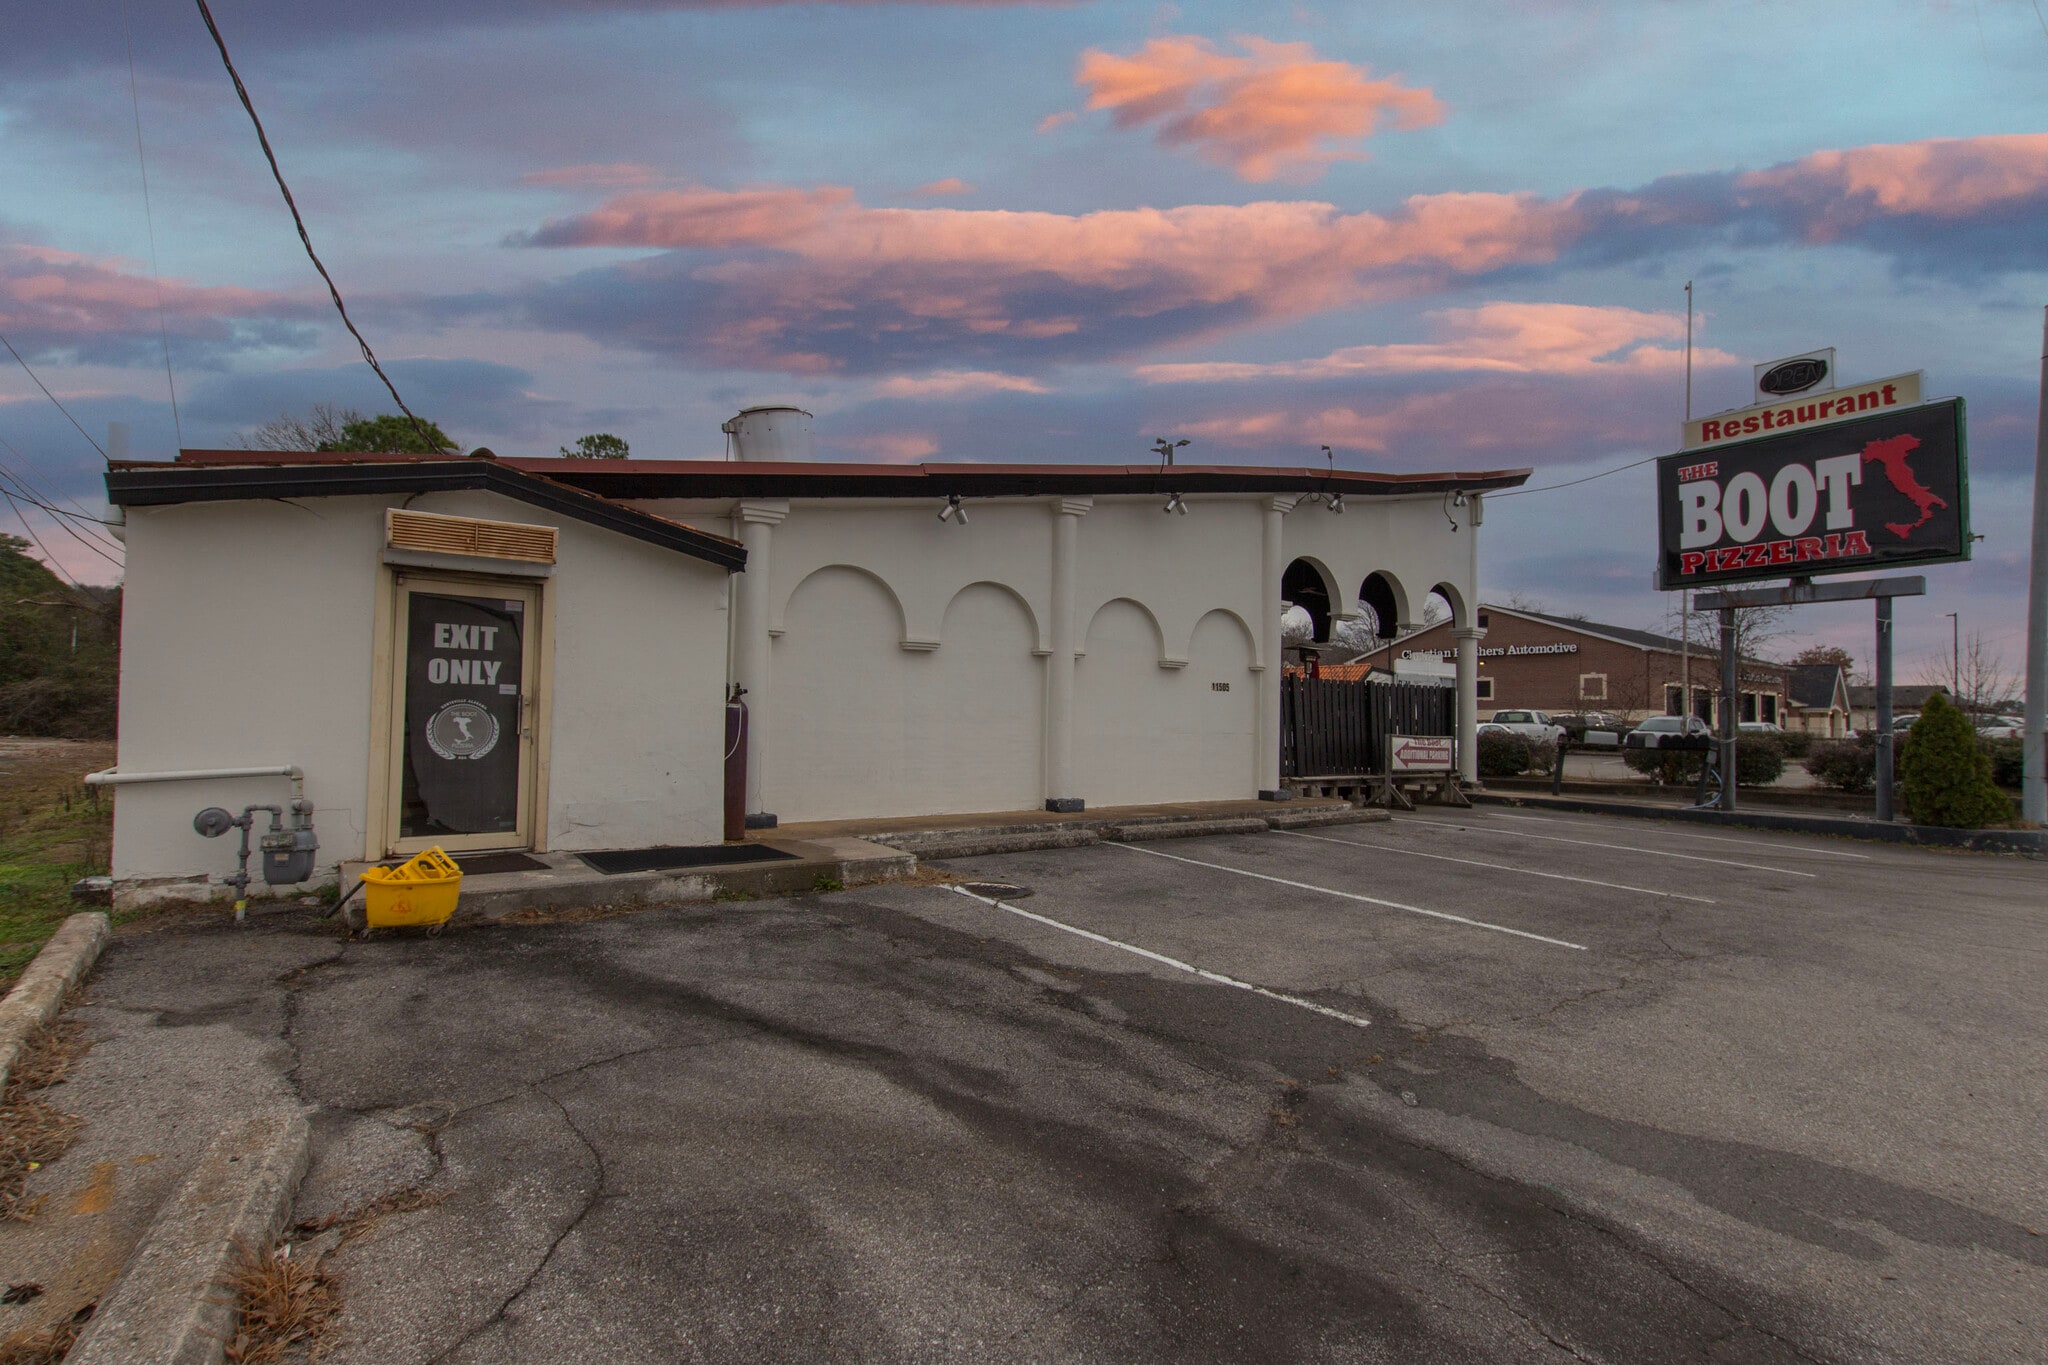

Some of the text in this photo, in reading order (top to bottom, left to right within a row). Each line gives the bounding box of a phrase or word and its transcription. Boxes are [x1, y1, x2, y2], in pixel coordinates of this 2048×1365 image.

[1702, 384, 1897, 442] Restaurant
[1678, 461, 1718, 481] THE
[1678, 453, 1862, 549] BOOT
[1680, 530, 1872, 574] PIZZERIA
[434, 622, 499, 651] EXIT
[1507, 642, 1578, 655] Automotive
[428, 658, 502, 685] ONLY
